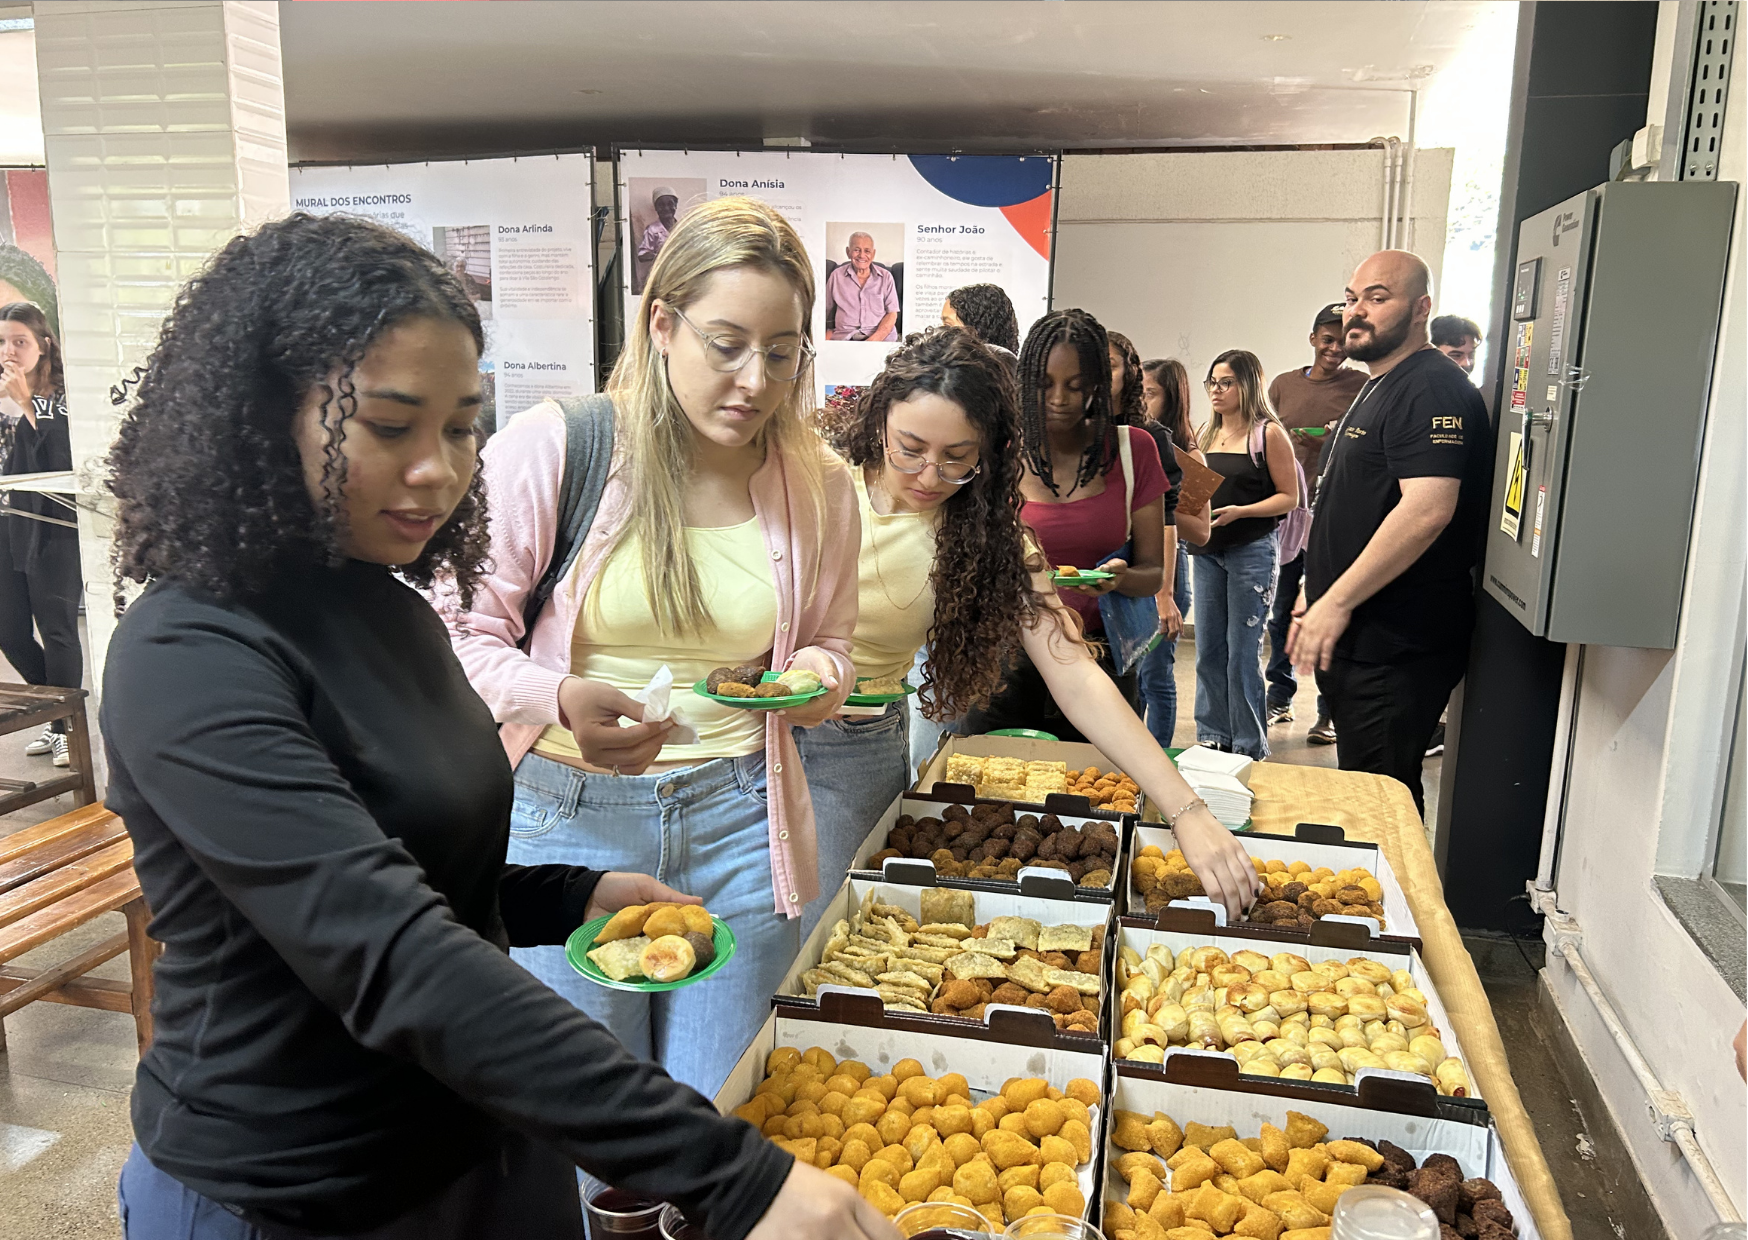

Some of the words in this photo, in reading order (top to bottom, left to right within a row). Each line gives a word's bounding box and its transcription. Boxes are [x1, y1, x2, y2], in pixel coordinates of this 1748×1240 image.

[720, 179, 748, 187] Dona
[752, 180, 784, 188] Anísia
[296, 198, 328, 208] MURAL
[331, 197, 350, 206] DOS
[353, 194, 411, 205] ENCONTROS
[522, 224, 552, 232] Arlinda
[918, 225, 956, 233] Senhor
[959, 226, 985, 234] João
[528, 362, 566, 370] Albertina
[1432, 417, 1463, 429] FEN
